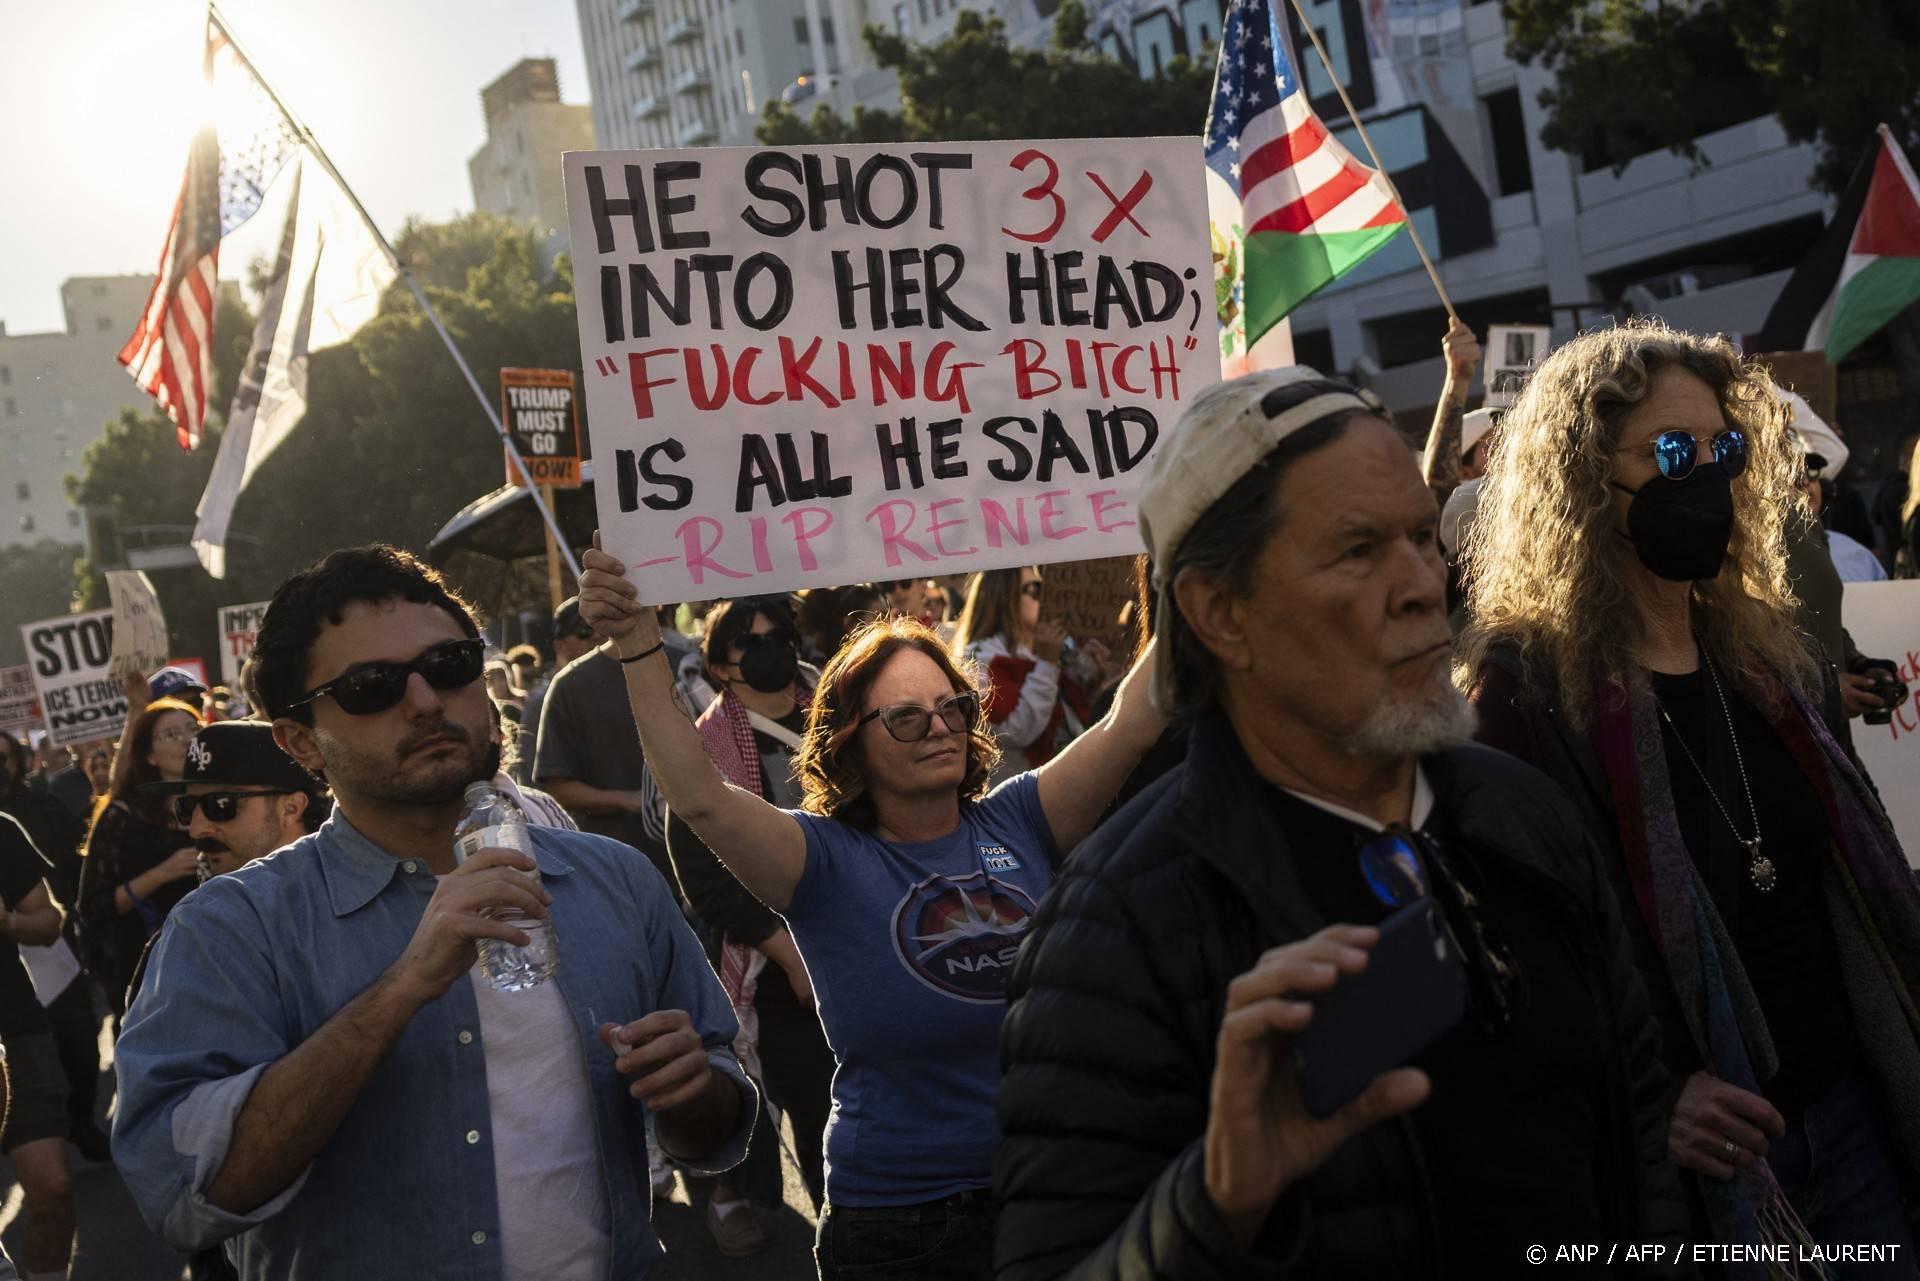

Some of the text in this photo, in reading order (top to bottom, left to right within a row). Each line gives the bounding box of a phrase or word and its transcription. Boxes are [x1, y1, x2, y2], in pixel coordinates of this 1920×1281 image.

[584, 161, 711, 254] HE
[741, 151, 972, 238] SHOT
[1002, 149, 1067, 243] 3
[599, 243, 1202, 343] INTO HER HEAD;
[596, 334, 1197, 419] "FUCKING BITCH"
[508, 387, 571, 409] TRUMP
[517, 410, 566, 432] MUST
[532, 432, 556, 454] GO
[615, 437, 693, 512] IS
[735, 431, 852, 512] ALL
[875, 417, 968, 492] HE
[866, 489, 1136, 567] RENEE
[225, 605, 263, 634] IMPE
[44, 686, 75, 712] ICE
[76, 678, 123, 705] TERR
[51, 701, 130, 728] NOW
[980, 846, 1007, 856] FUCK
[945, 947, 1018, 975] NAS
